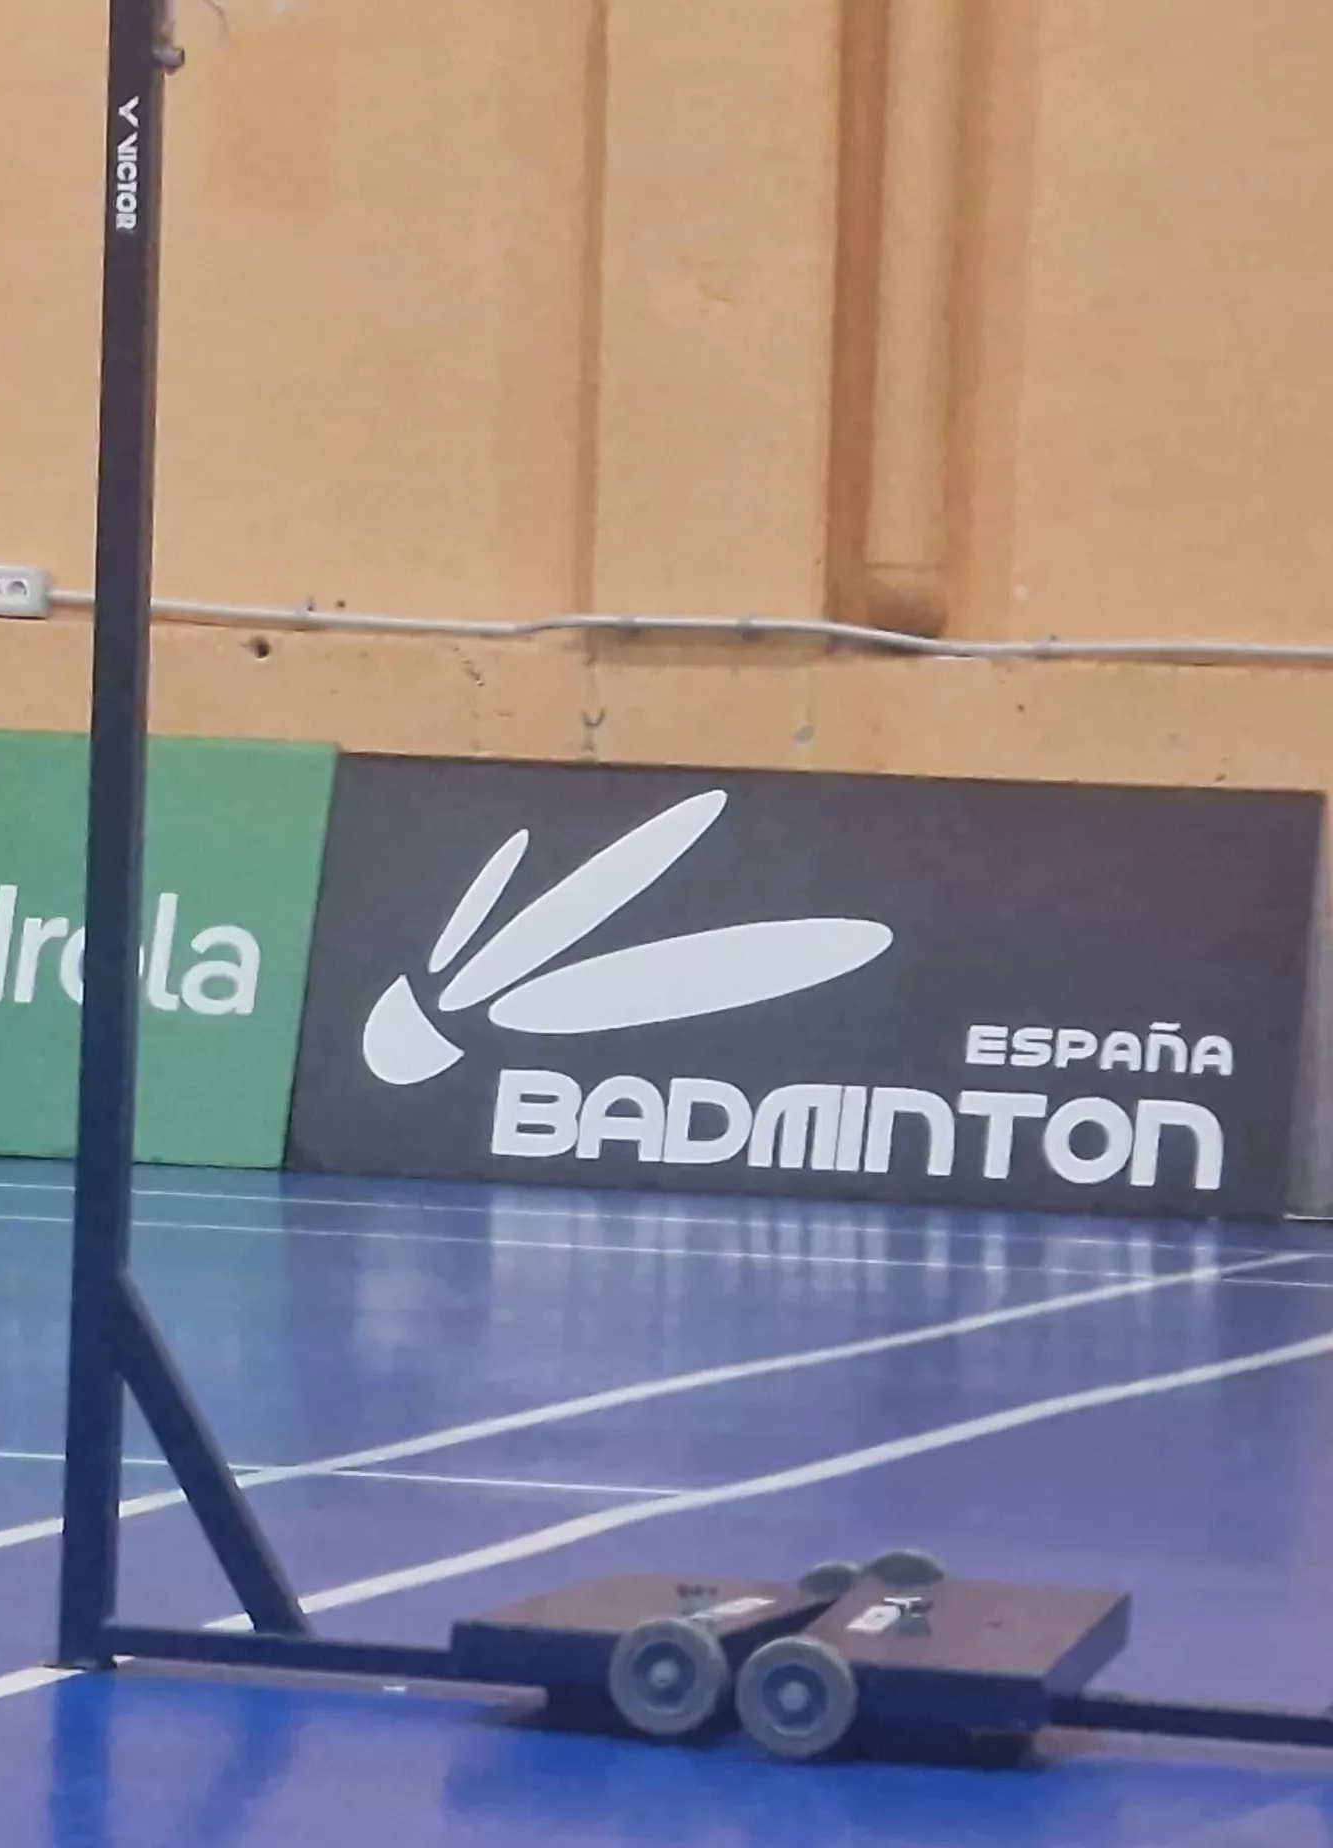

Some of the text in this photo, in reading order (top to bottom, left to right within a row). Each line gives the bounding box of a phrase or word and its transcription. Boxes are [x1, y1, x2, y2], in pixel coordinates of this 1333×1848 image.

[115, 131, 139, 230] VICTOR
[964, 1021, 1234, 1077] ESPAÑA
[490, 1068, 1225, 1191] BADMINTON
